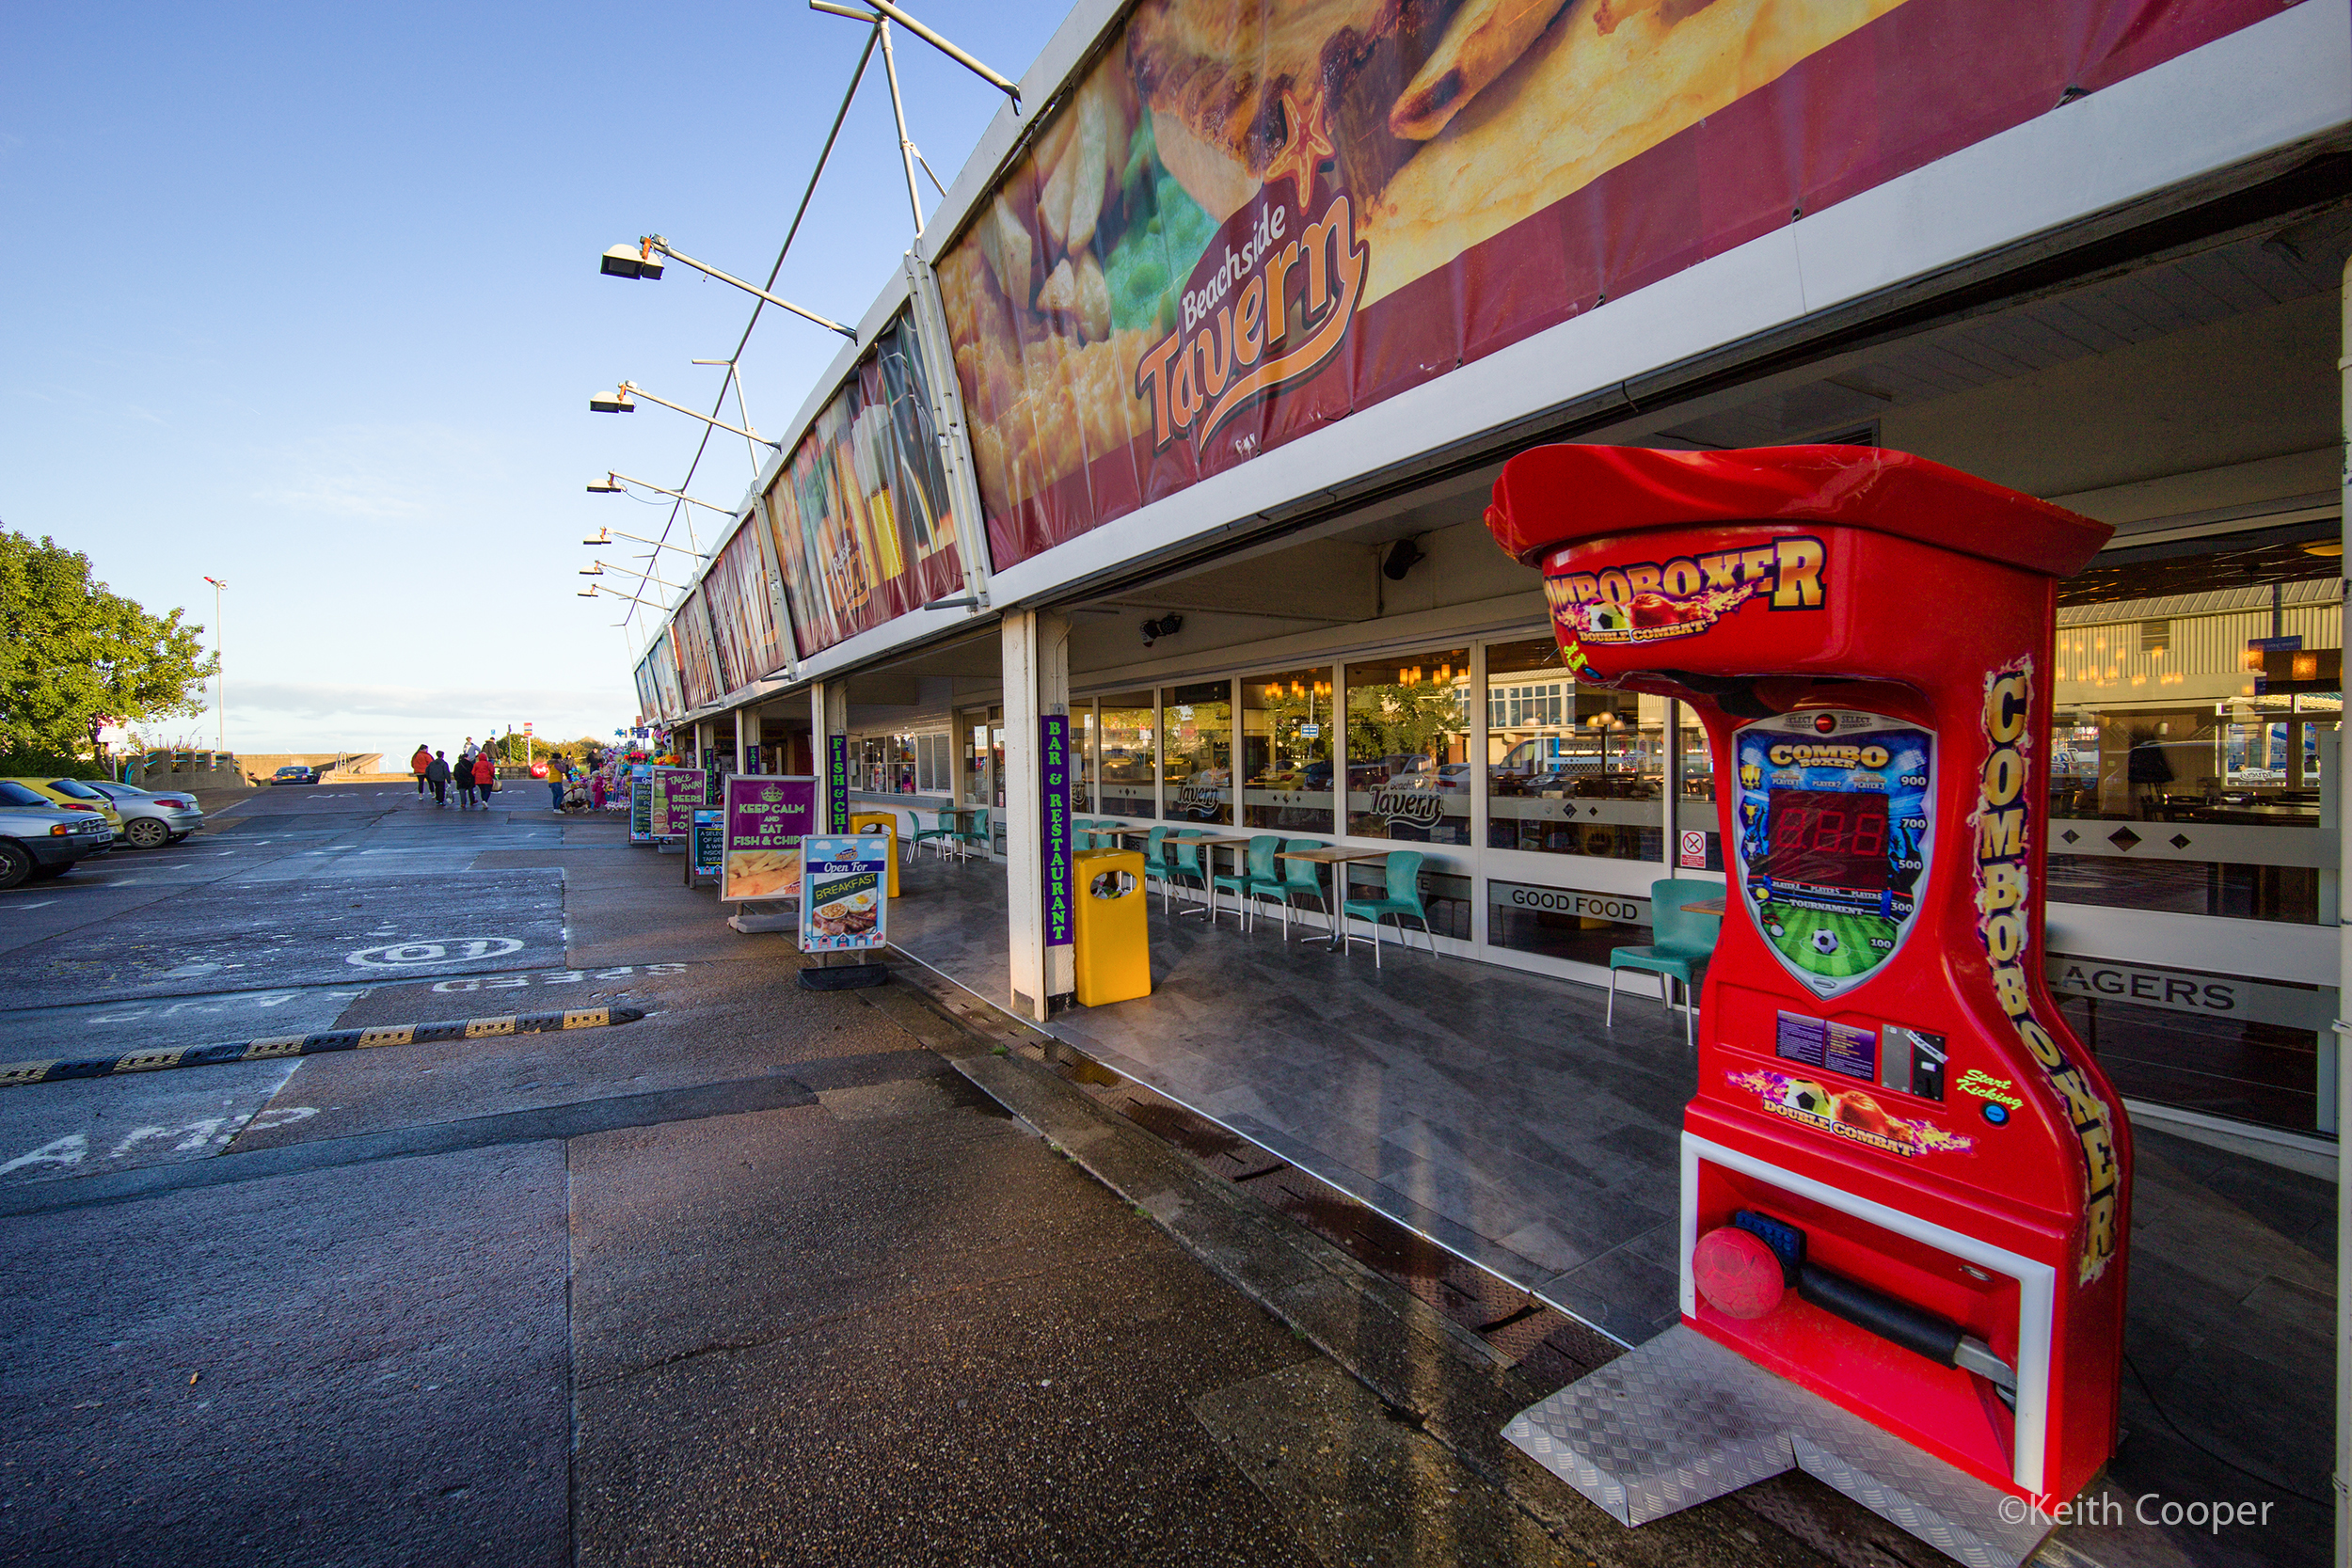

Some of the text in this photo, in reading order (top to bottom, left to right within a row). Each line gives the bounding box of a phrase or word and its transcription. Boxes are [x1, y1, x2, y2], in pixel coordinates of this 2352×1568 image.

[1182, 202, 1286, 334] Beachside
[1139, 195, 1364, 449] Tavern
[1579, 619, 1708, 643] DOUBLE COMBAT
[833, 737, 845, 785] FISH
[1769, 744, 1890, 768] COMBO
[1798, 757, 1857, 769] BOXER
[667, 773, 692, 785] TAKE
[680, 779, 703, 792] AWAY
[1900, 776, 1927, 786] 900
[673, 794, 703, 802] BEERS
[834, 788, 845, 799] &
[1176, 780, 1219, 806] Tavern
[1369, 784, 1444, 821] Tavern
[739, 803, 805, 814] KEEP CALM
[672, 821, 689, 830] FO
[759, 824, 784, 834] EAT
[1048, 721, 1066, 940] BAR & RESTAURANT
[1901, 818, 1927, 829] 700
[734, 836, 760, 846] FISH
[761, 835, 771, 846] &
[824, 861, 868, 877] Open For
[1898, 859, 1922, 870] 500
[815, 873, 876, 900] BREAKFAST
[1512, 889, 1638, 920] GOOD FOOD
[1788, 897, 1864, 916] TOURNAMENT
[1891, 902, 1914, 912] 300
[385, 941, 488, 961] 10
[1870, 938, 1892, 949] 100
[431, 962, 688, 993] SPEED
[2048, 965, 2235, 1011] AGERS
[1963, 1069, 2012, 1090] Start
[1956, 1078, 2024, 1111] Kicking
[1763, 1098, 1915, 1158] DOUBLE COMBAT
